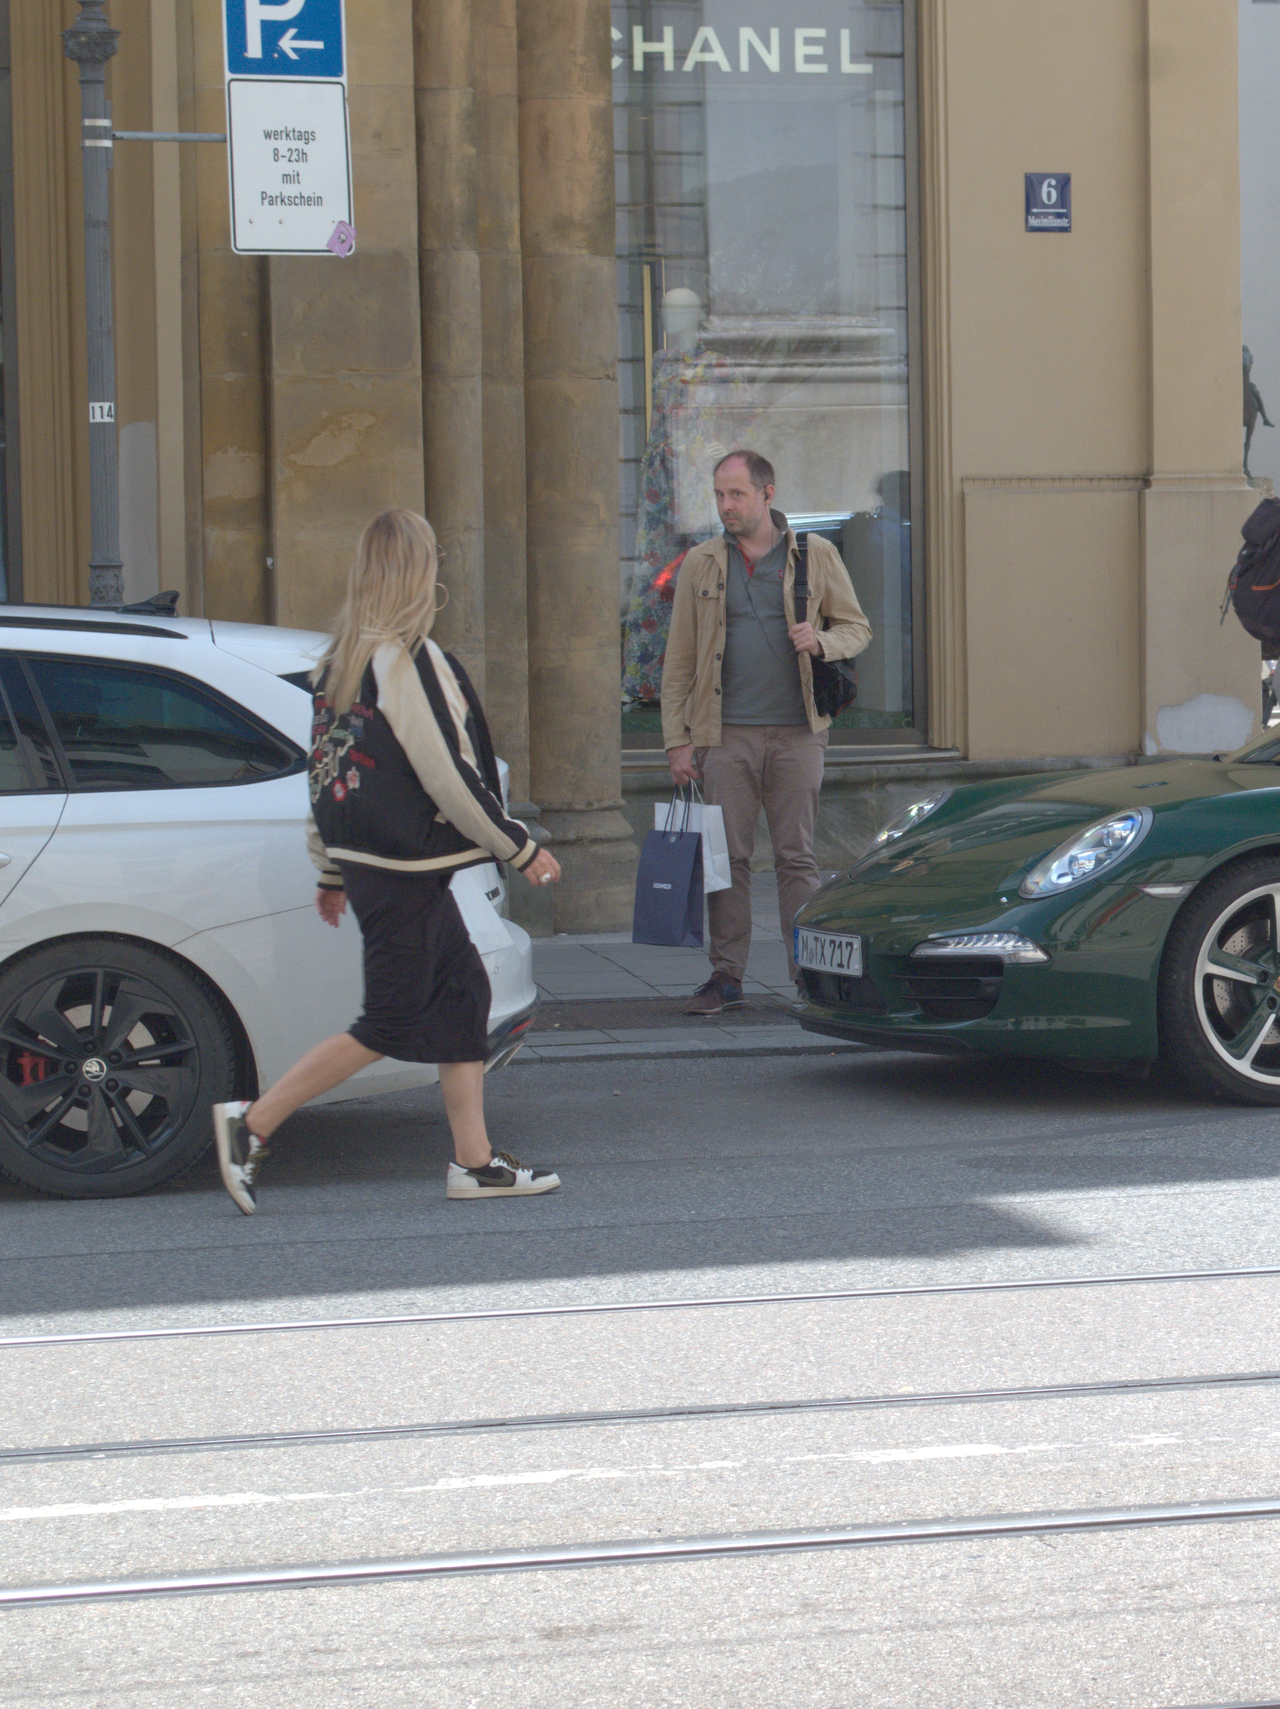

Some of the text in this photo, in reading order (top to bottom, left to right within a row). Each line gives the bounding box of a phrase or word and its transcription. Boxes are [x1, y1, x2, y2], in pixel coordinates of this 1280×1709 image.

[263, 126, 316, 145] werktags
[273, 147, 308, 163] 8-23h
[282, 170, 301, 184] mit
[261, 190, 323, 206] Parkschein
[1041, 178, 1057, 205] 6
[91, 405, 114, 420] 114
[802, 934, 809, 962] M
[829, 939, 854, 970] 717
